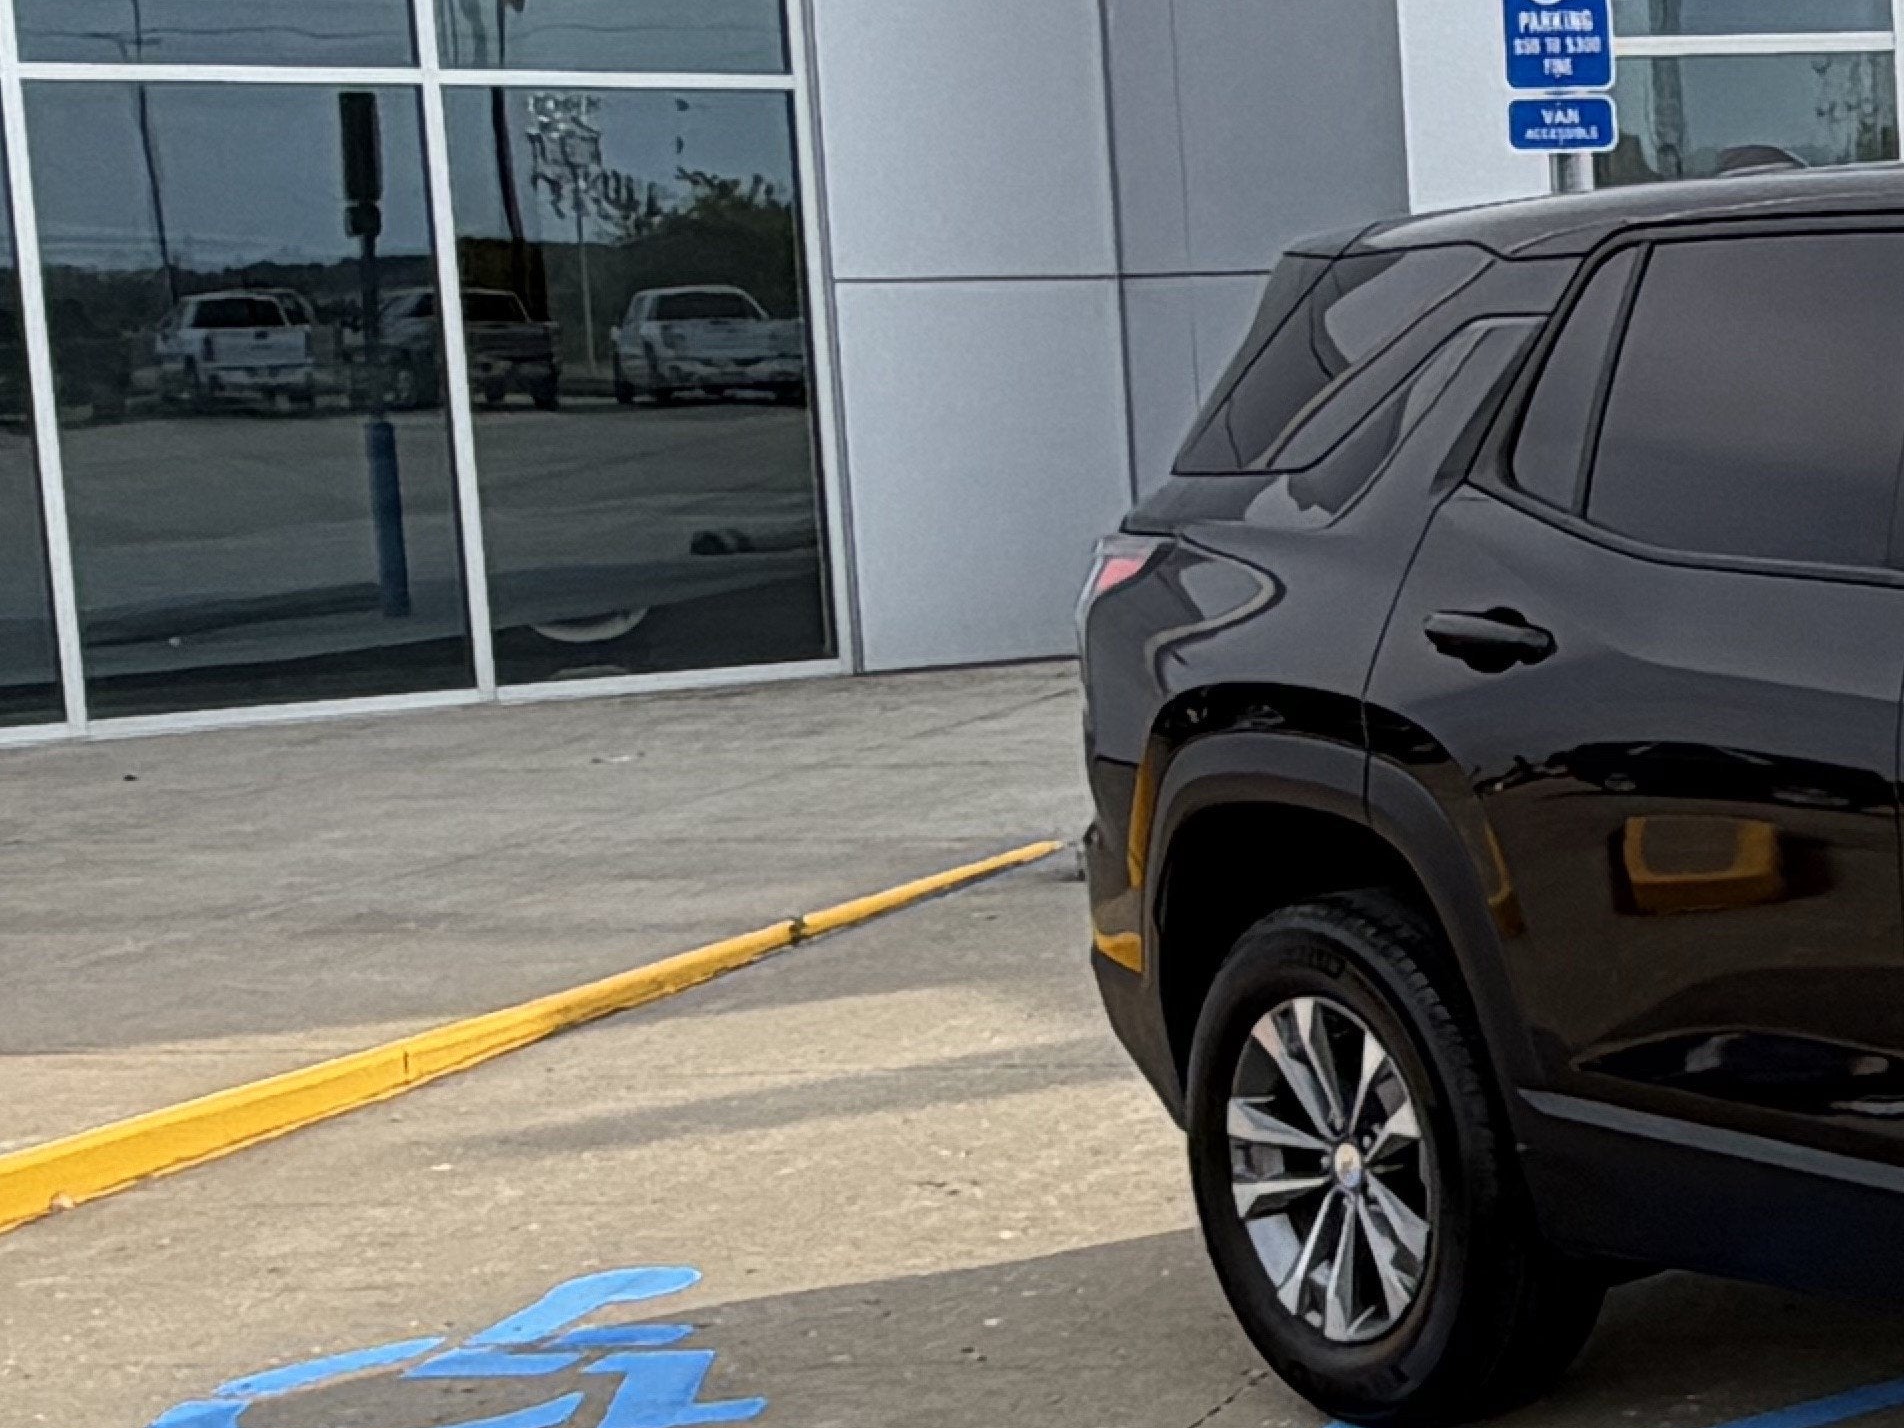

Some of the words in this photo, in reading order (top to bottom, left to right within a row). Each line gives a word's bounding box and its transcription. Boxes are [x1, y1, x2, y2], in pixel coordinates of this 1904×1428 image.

[1518, 9, 1594, 33] PARKING
[1544, 37, 1562, 54] TO
[1541, 108, 1580, 124] VAN
